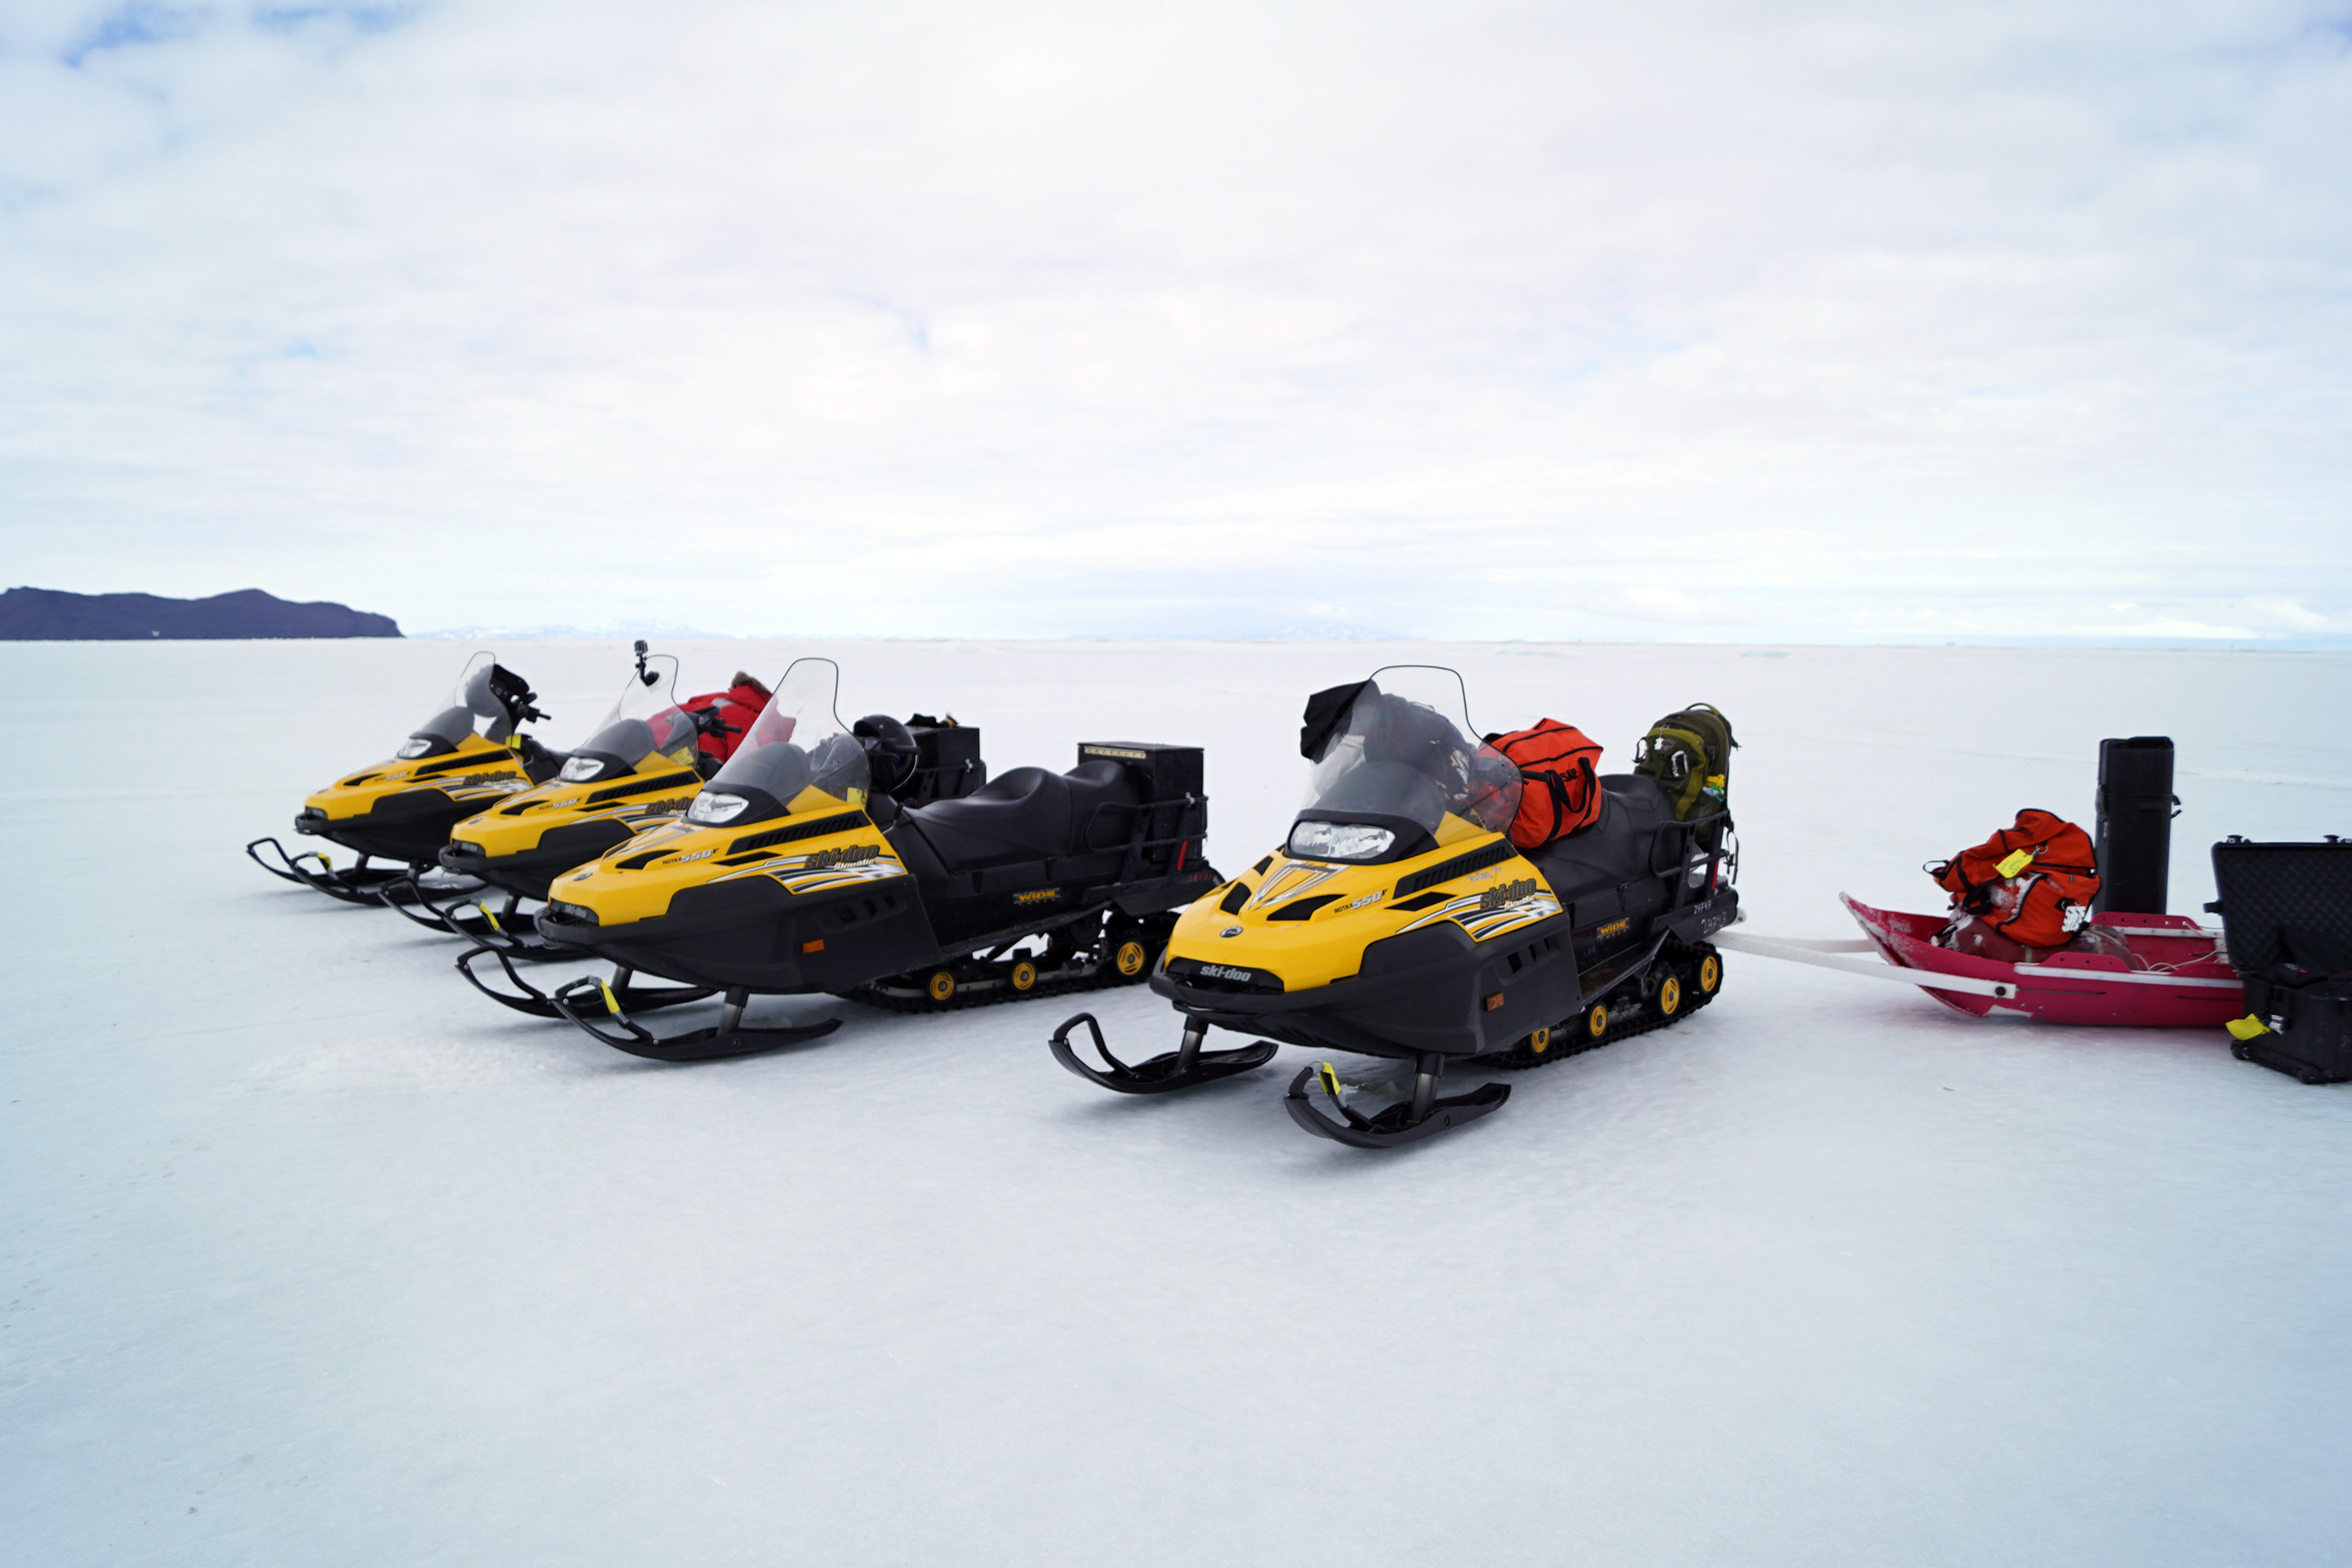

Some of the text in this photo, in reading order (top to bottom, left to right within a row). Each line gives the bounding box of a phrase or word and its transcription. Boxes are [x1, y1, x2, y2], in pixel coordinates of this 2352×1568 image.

[1561, 768, 1578, 782] SAP
[804, 844, 880, 870] ski-doo
[1018, 890, 1056, 902] WIDE
[1480, 878, 1536, 911] ski-doo
[1334, 903, 1353, 914] ROTAX
[1200, 964, 1251, 982] ski-doo
